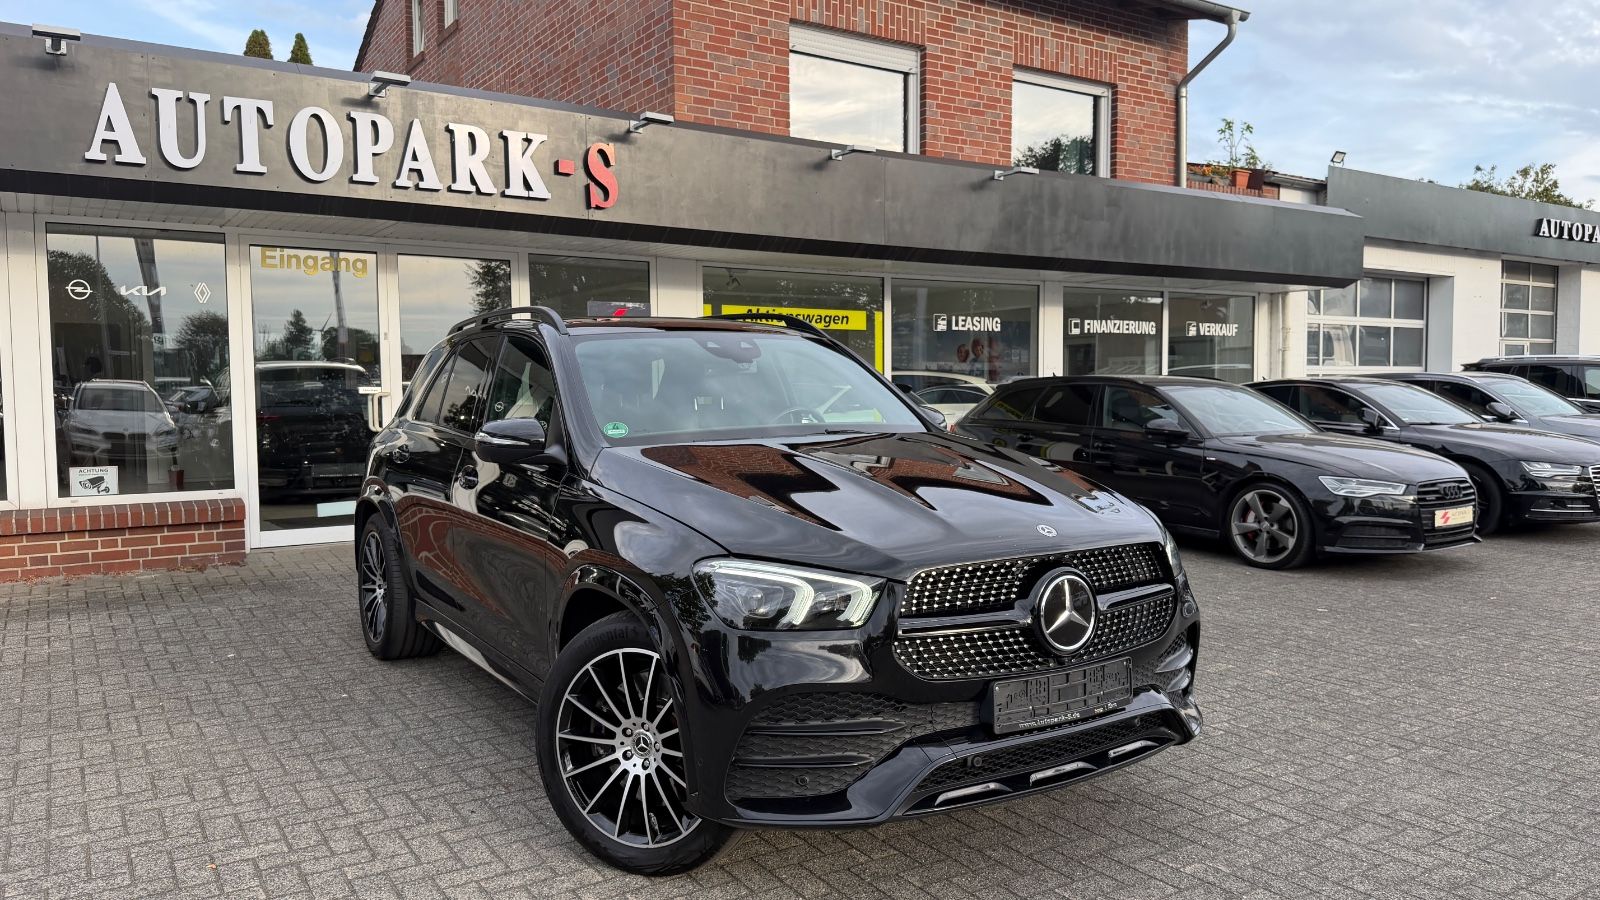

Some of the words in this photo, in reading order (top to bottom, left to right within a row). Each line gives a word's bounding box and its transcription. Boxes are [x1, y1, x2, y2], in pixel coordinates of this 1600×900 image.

[84, 82, 620, 210] AUTOPARK-S
[1539, 217, 1600, 243] AUTOPA
[260, 246, 368, 278] Eingang
[743, 308, 850, 328] Aktiswagen
[951, 315, 1001, 332] LEASING
[1084, 319, 1156, 335] FINANZIERUNG
[1199, 322, 1239, 337] VERKAUF
